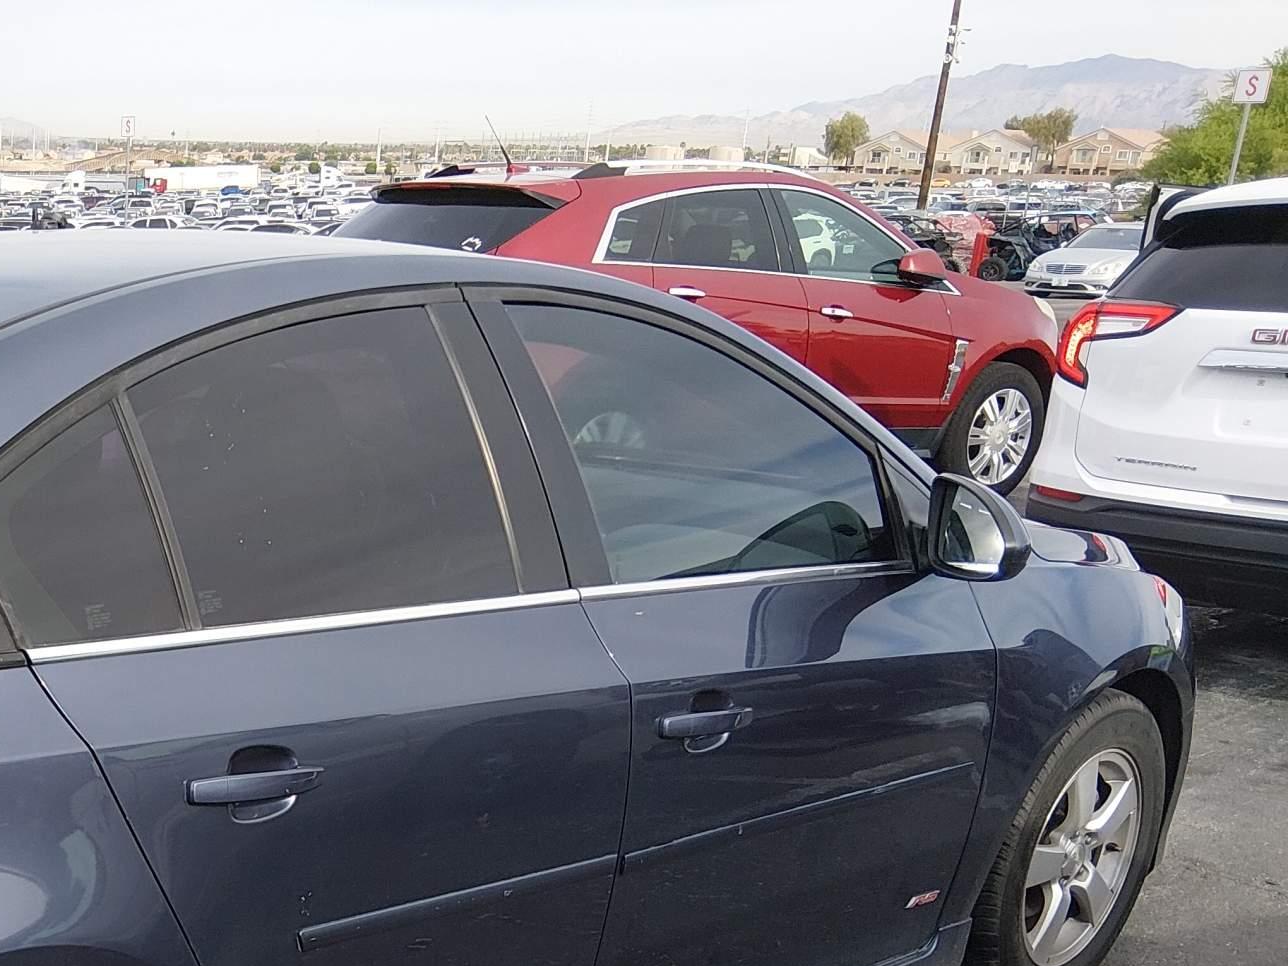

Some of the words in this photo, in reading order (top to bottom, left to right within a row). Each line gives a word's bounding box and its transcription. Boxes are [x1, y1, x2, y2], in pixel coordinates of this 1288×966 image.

[1245, 75, 1259, 97] S
[1249, 327, 1288, 345] G
[1114, 456, 1198, 472] TERRAIN
